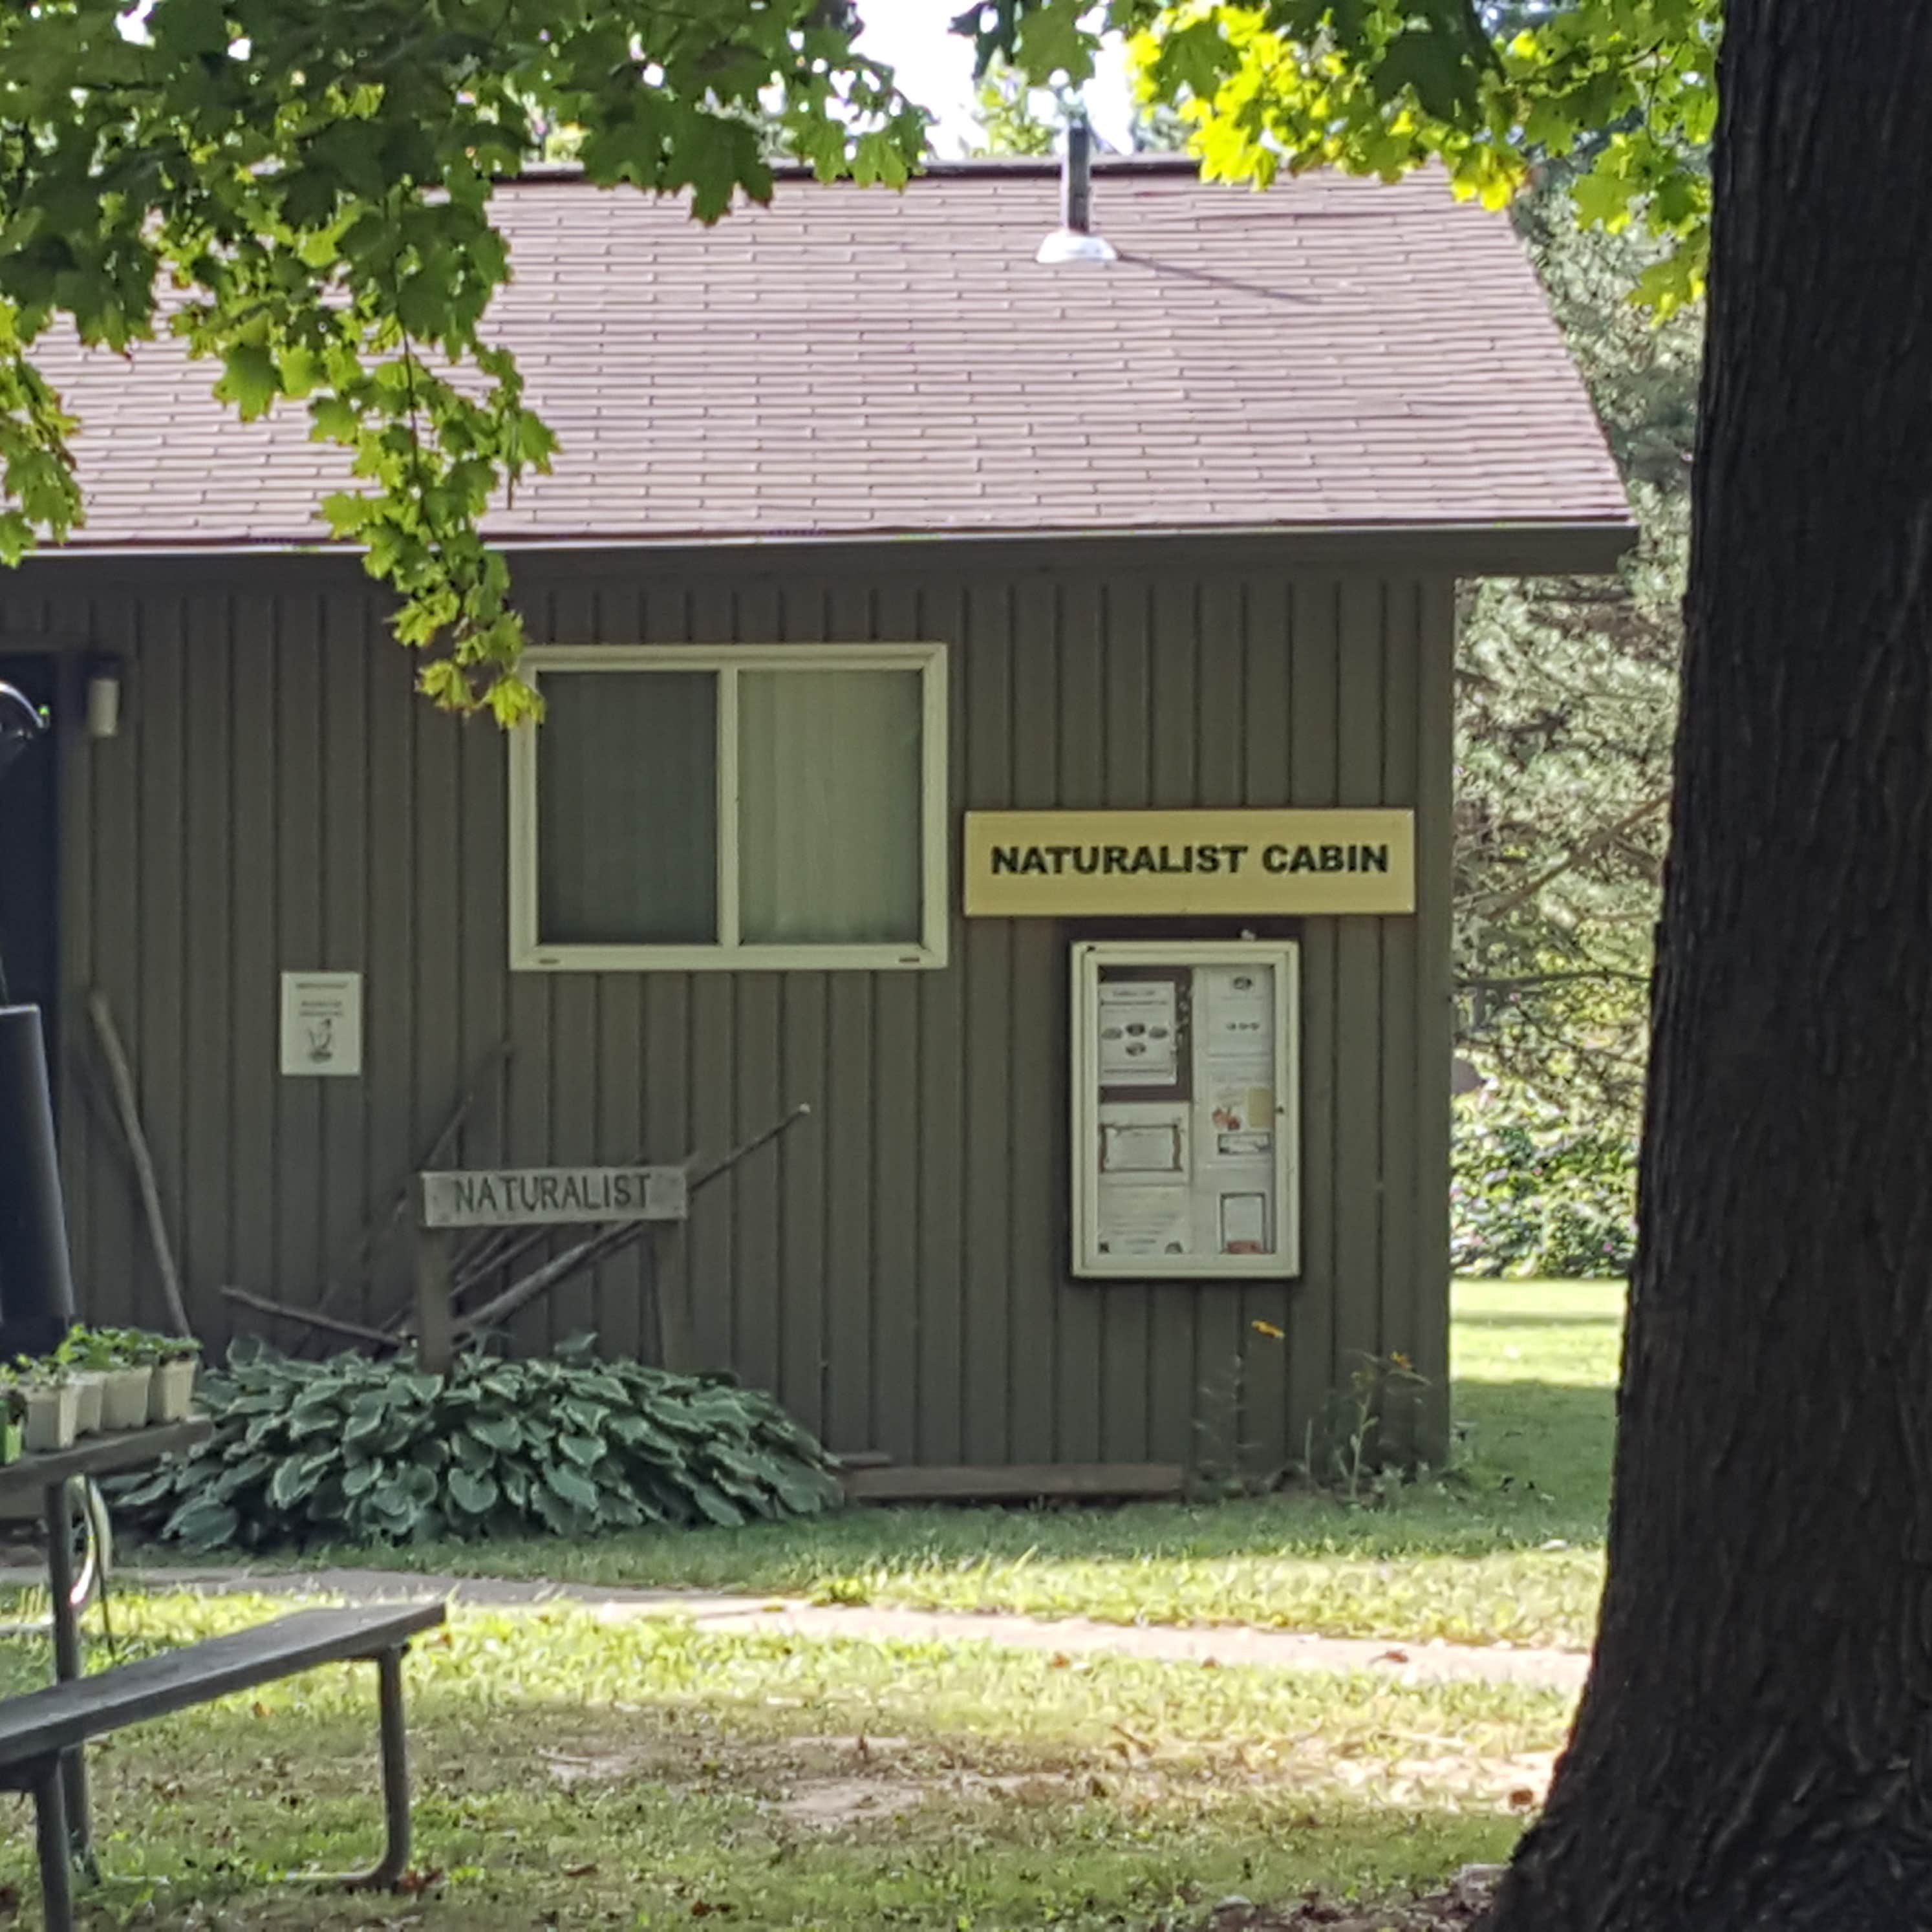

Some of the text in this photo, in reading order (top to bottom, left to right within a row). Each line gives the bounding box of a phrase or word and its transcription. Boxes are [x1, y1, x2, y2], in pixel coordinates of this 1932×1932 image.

[991, 844, 1389, 874] NATURALIST CABIN
[455, 1173, 650, 1212] NATURALIST
